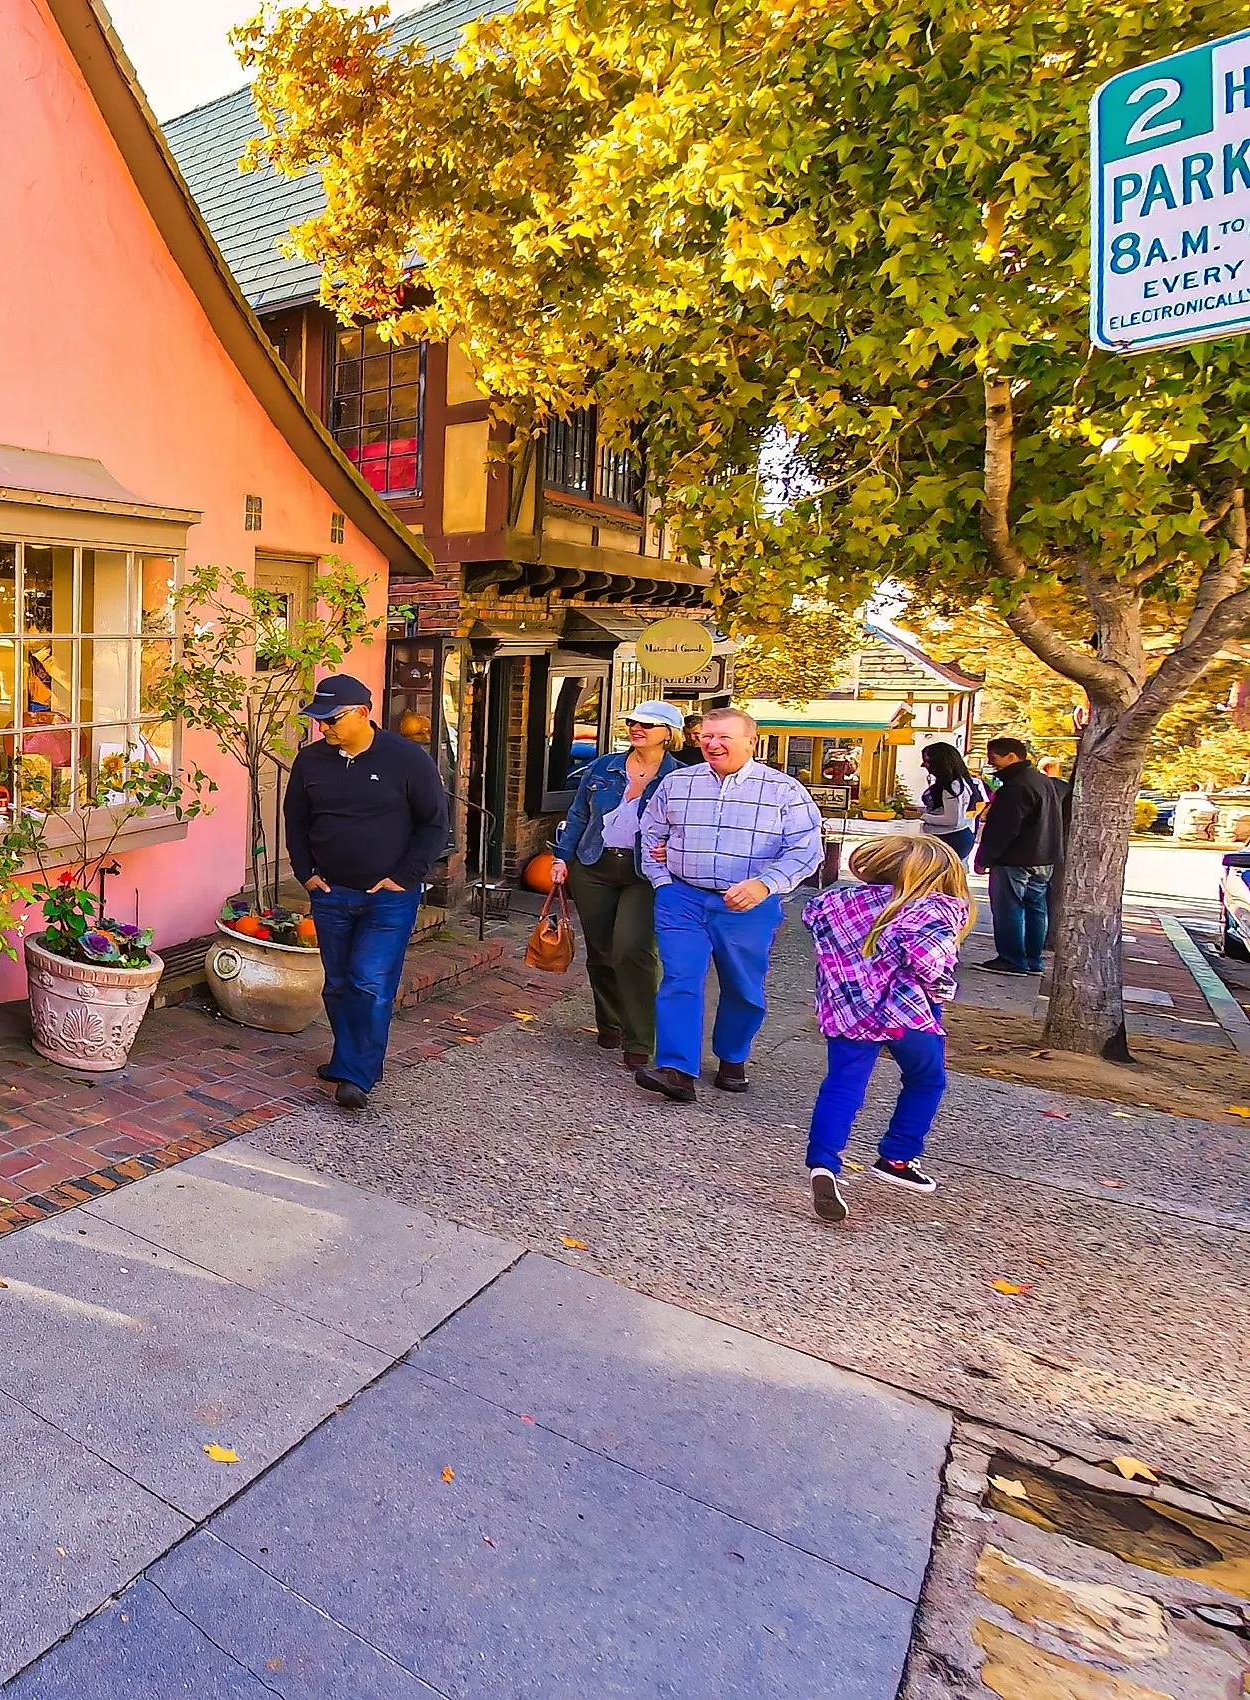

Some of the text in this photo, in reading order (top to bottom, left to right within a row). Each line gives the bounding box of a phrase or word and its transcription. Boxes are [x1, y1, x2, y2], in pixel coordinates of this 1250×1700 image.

[1125, 78, 1183, 146] 2
[1112, 138, 1250, 225] PARK
[1219, 218, 1245, 235] TO
[1143, 259, 1245, 299] EVERY
[664, 676, 710, 684] ALLERY
